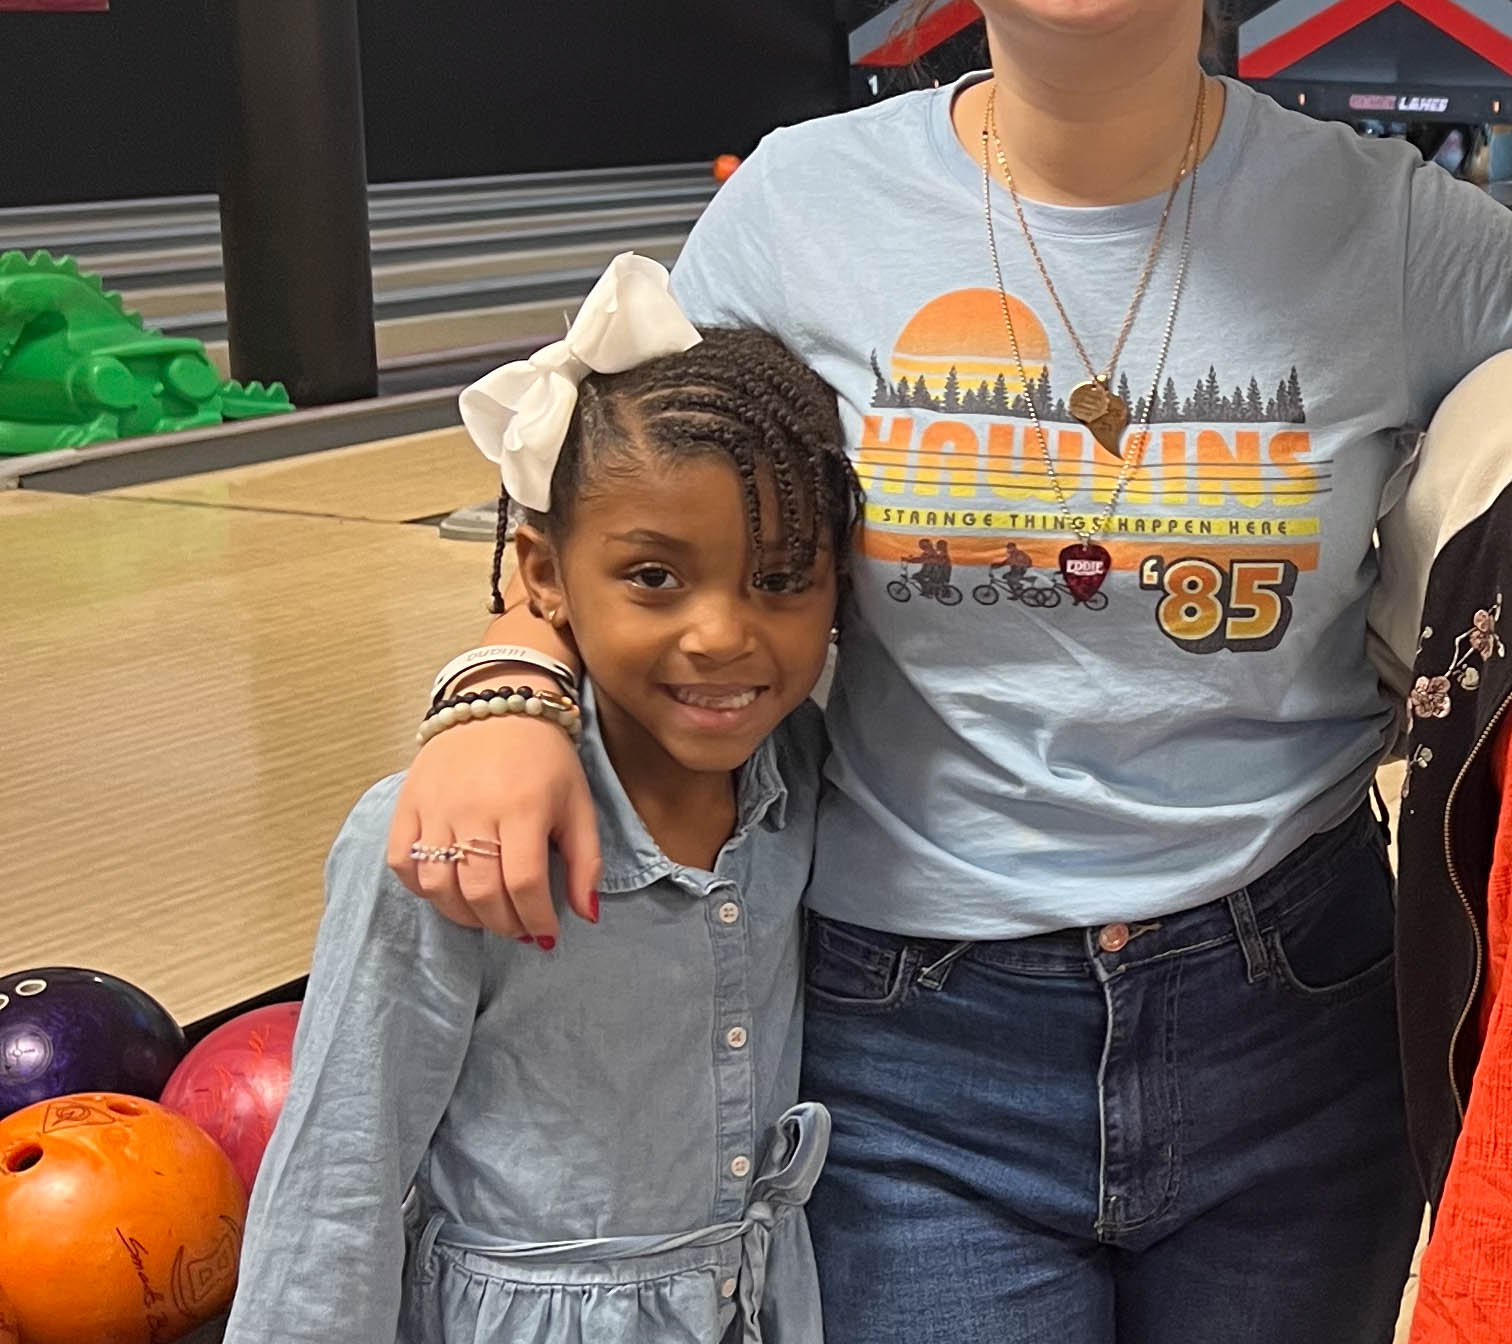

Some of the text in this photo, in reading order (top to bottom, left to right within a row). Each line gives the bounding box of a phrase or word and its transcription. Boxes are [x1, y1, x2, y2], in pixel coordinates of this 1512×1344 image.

[867, 74, 878, 96] 1
[857, 416, 1319, 508] HAWKINS
[883, 508, 1288, 535] STRANGE THINGS HAPPEN HERE
